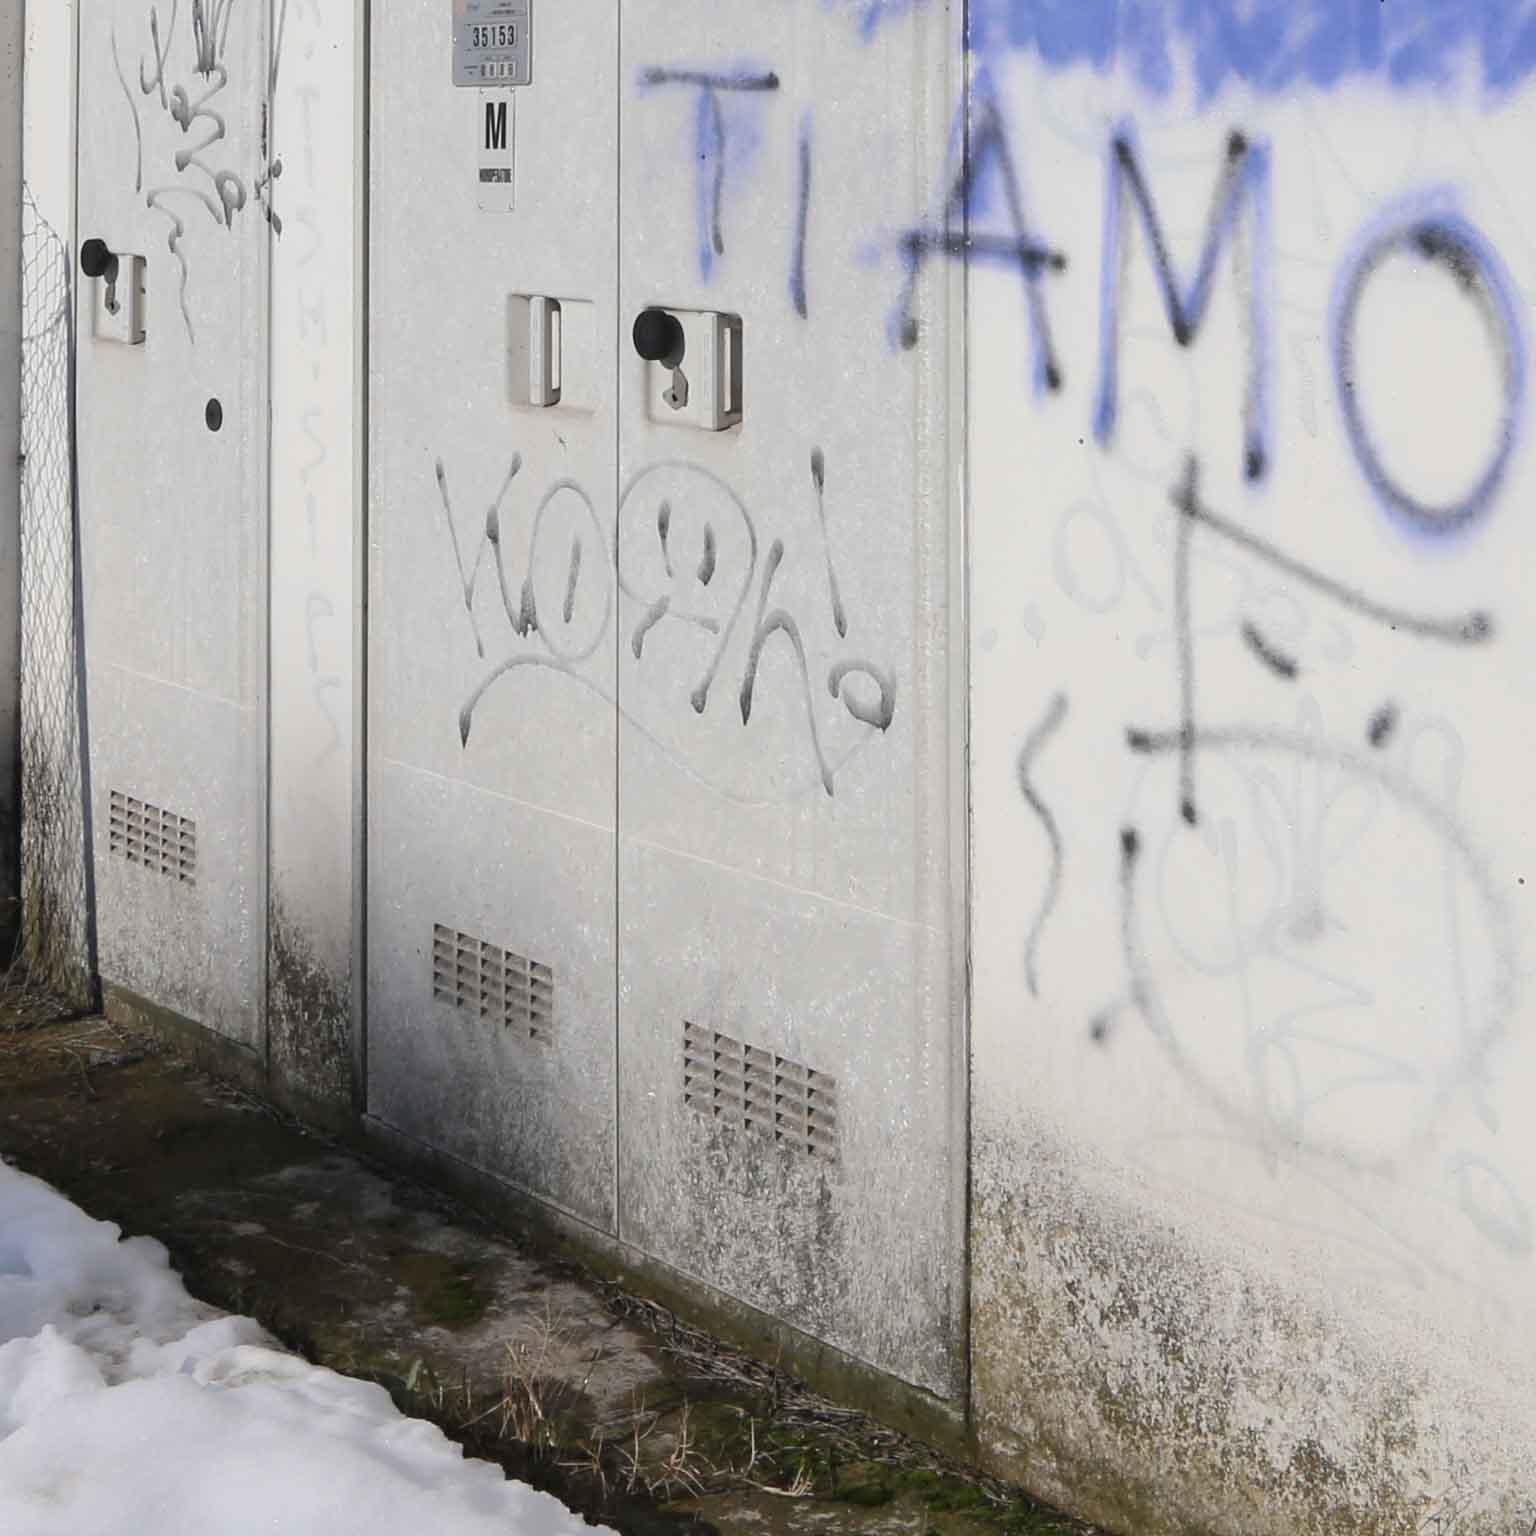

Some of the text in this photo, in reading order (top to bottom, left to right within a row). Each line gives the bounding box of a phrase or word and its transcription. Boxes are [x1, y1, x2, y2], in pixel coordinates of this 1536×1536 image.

[472, 25, 515, 48] 35153
[485, 102, 507, 150] M
[636, 65, 811, 321] TI
[887, 62, 1530, 556] AMO
